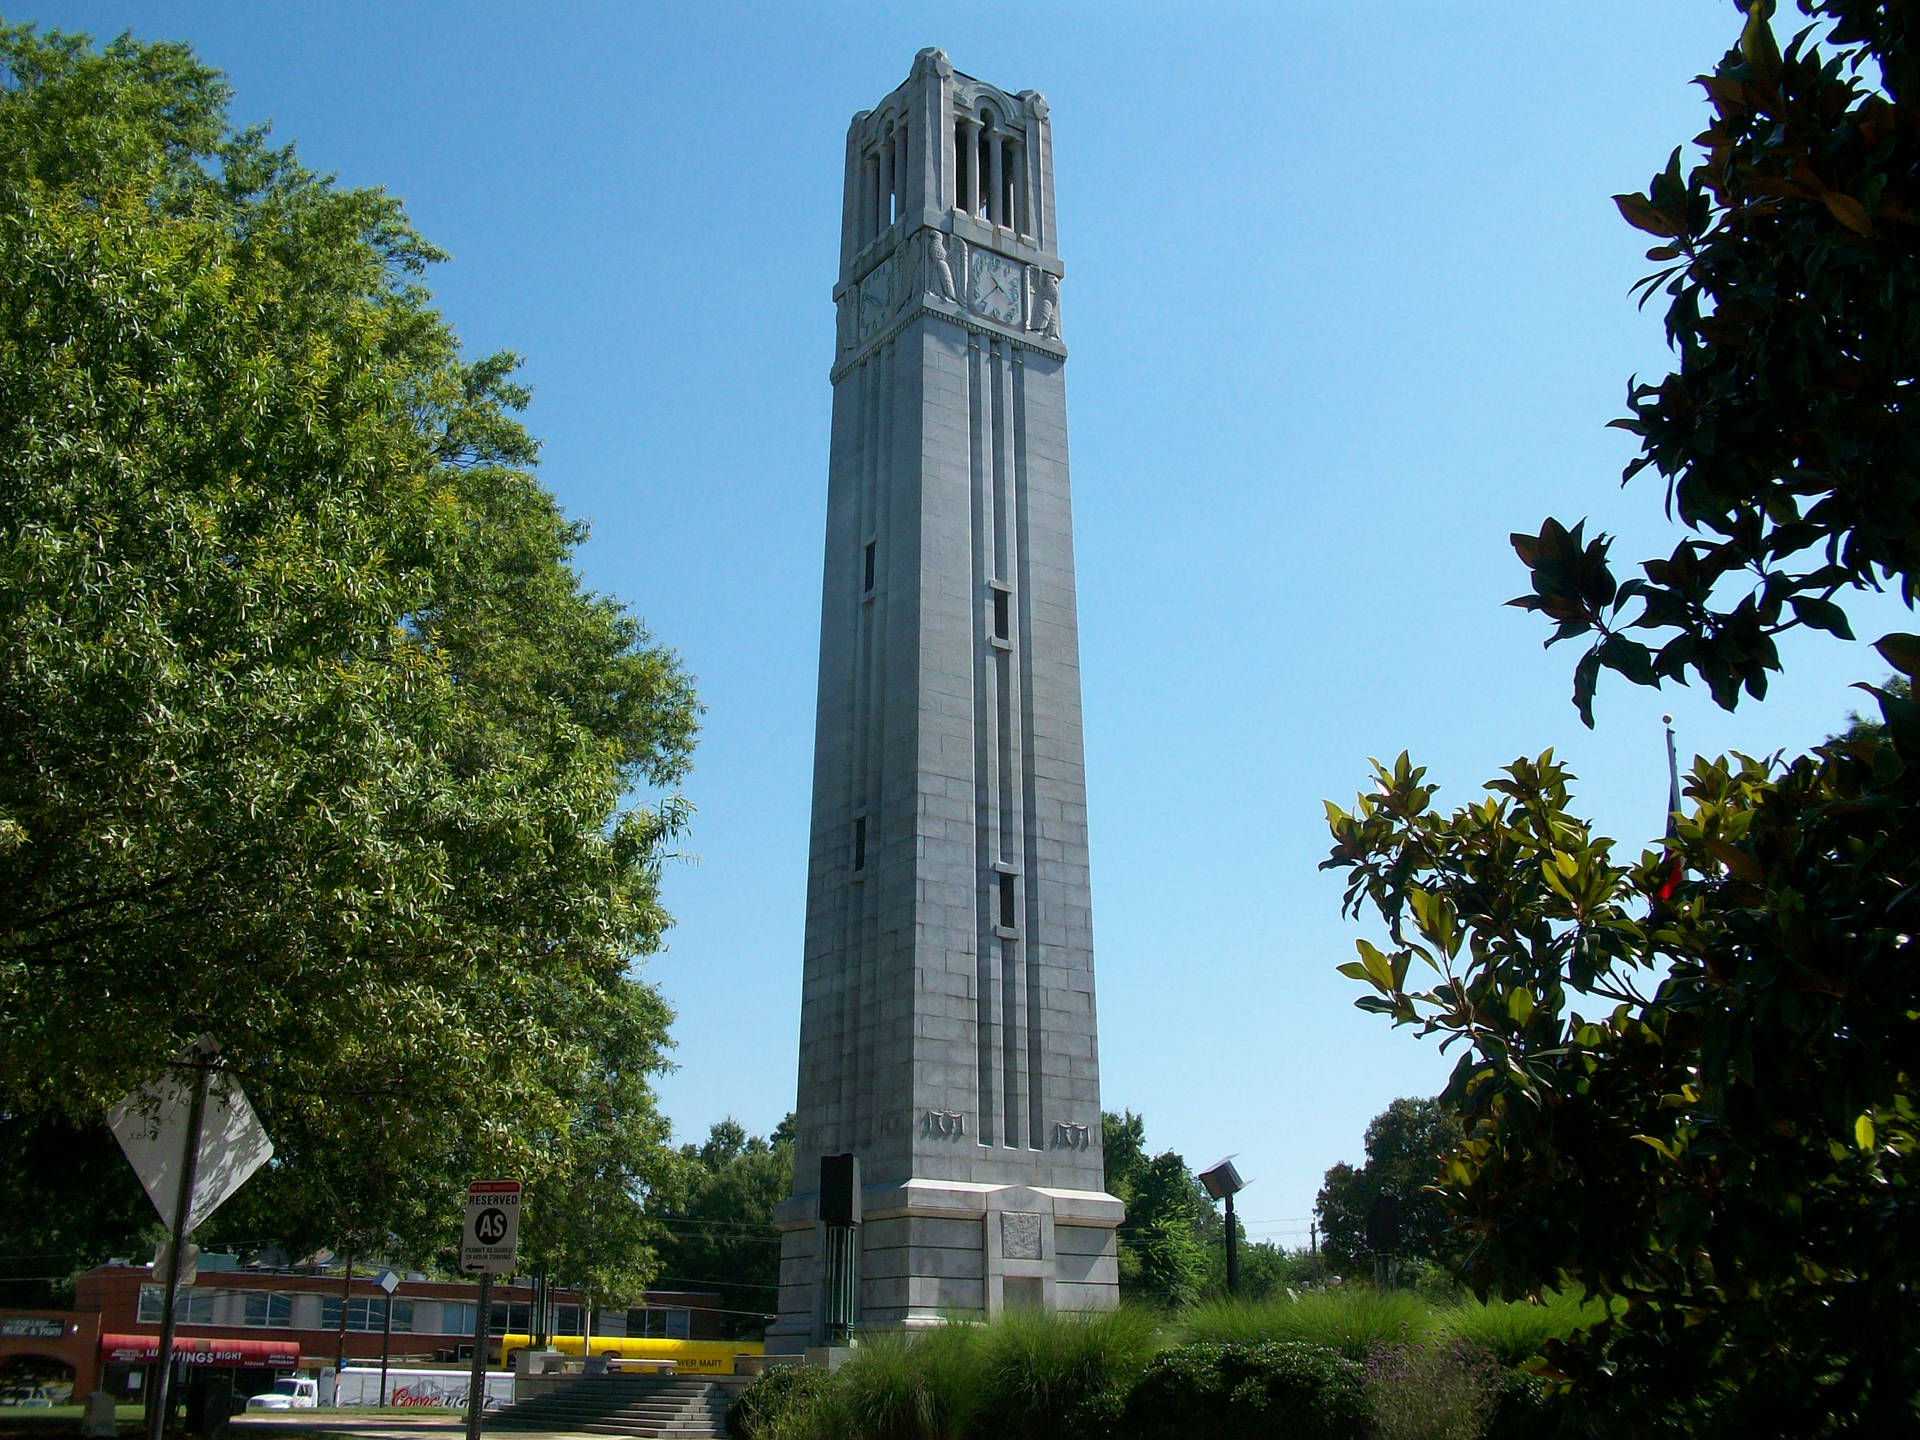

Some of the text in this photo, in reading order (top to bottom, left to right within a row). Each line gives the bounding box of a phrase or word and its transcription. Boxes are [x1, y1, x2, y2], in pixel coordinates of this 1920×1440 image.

[469, 1194, 518, 1205] RESERVED
[479, 1214, 504, 1237] AS
[216, 1351, 243, 1360] RIGHT
[699, 1359, 722, 1367] MART
